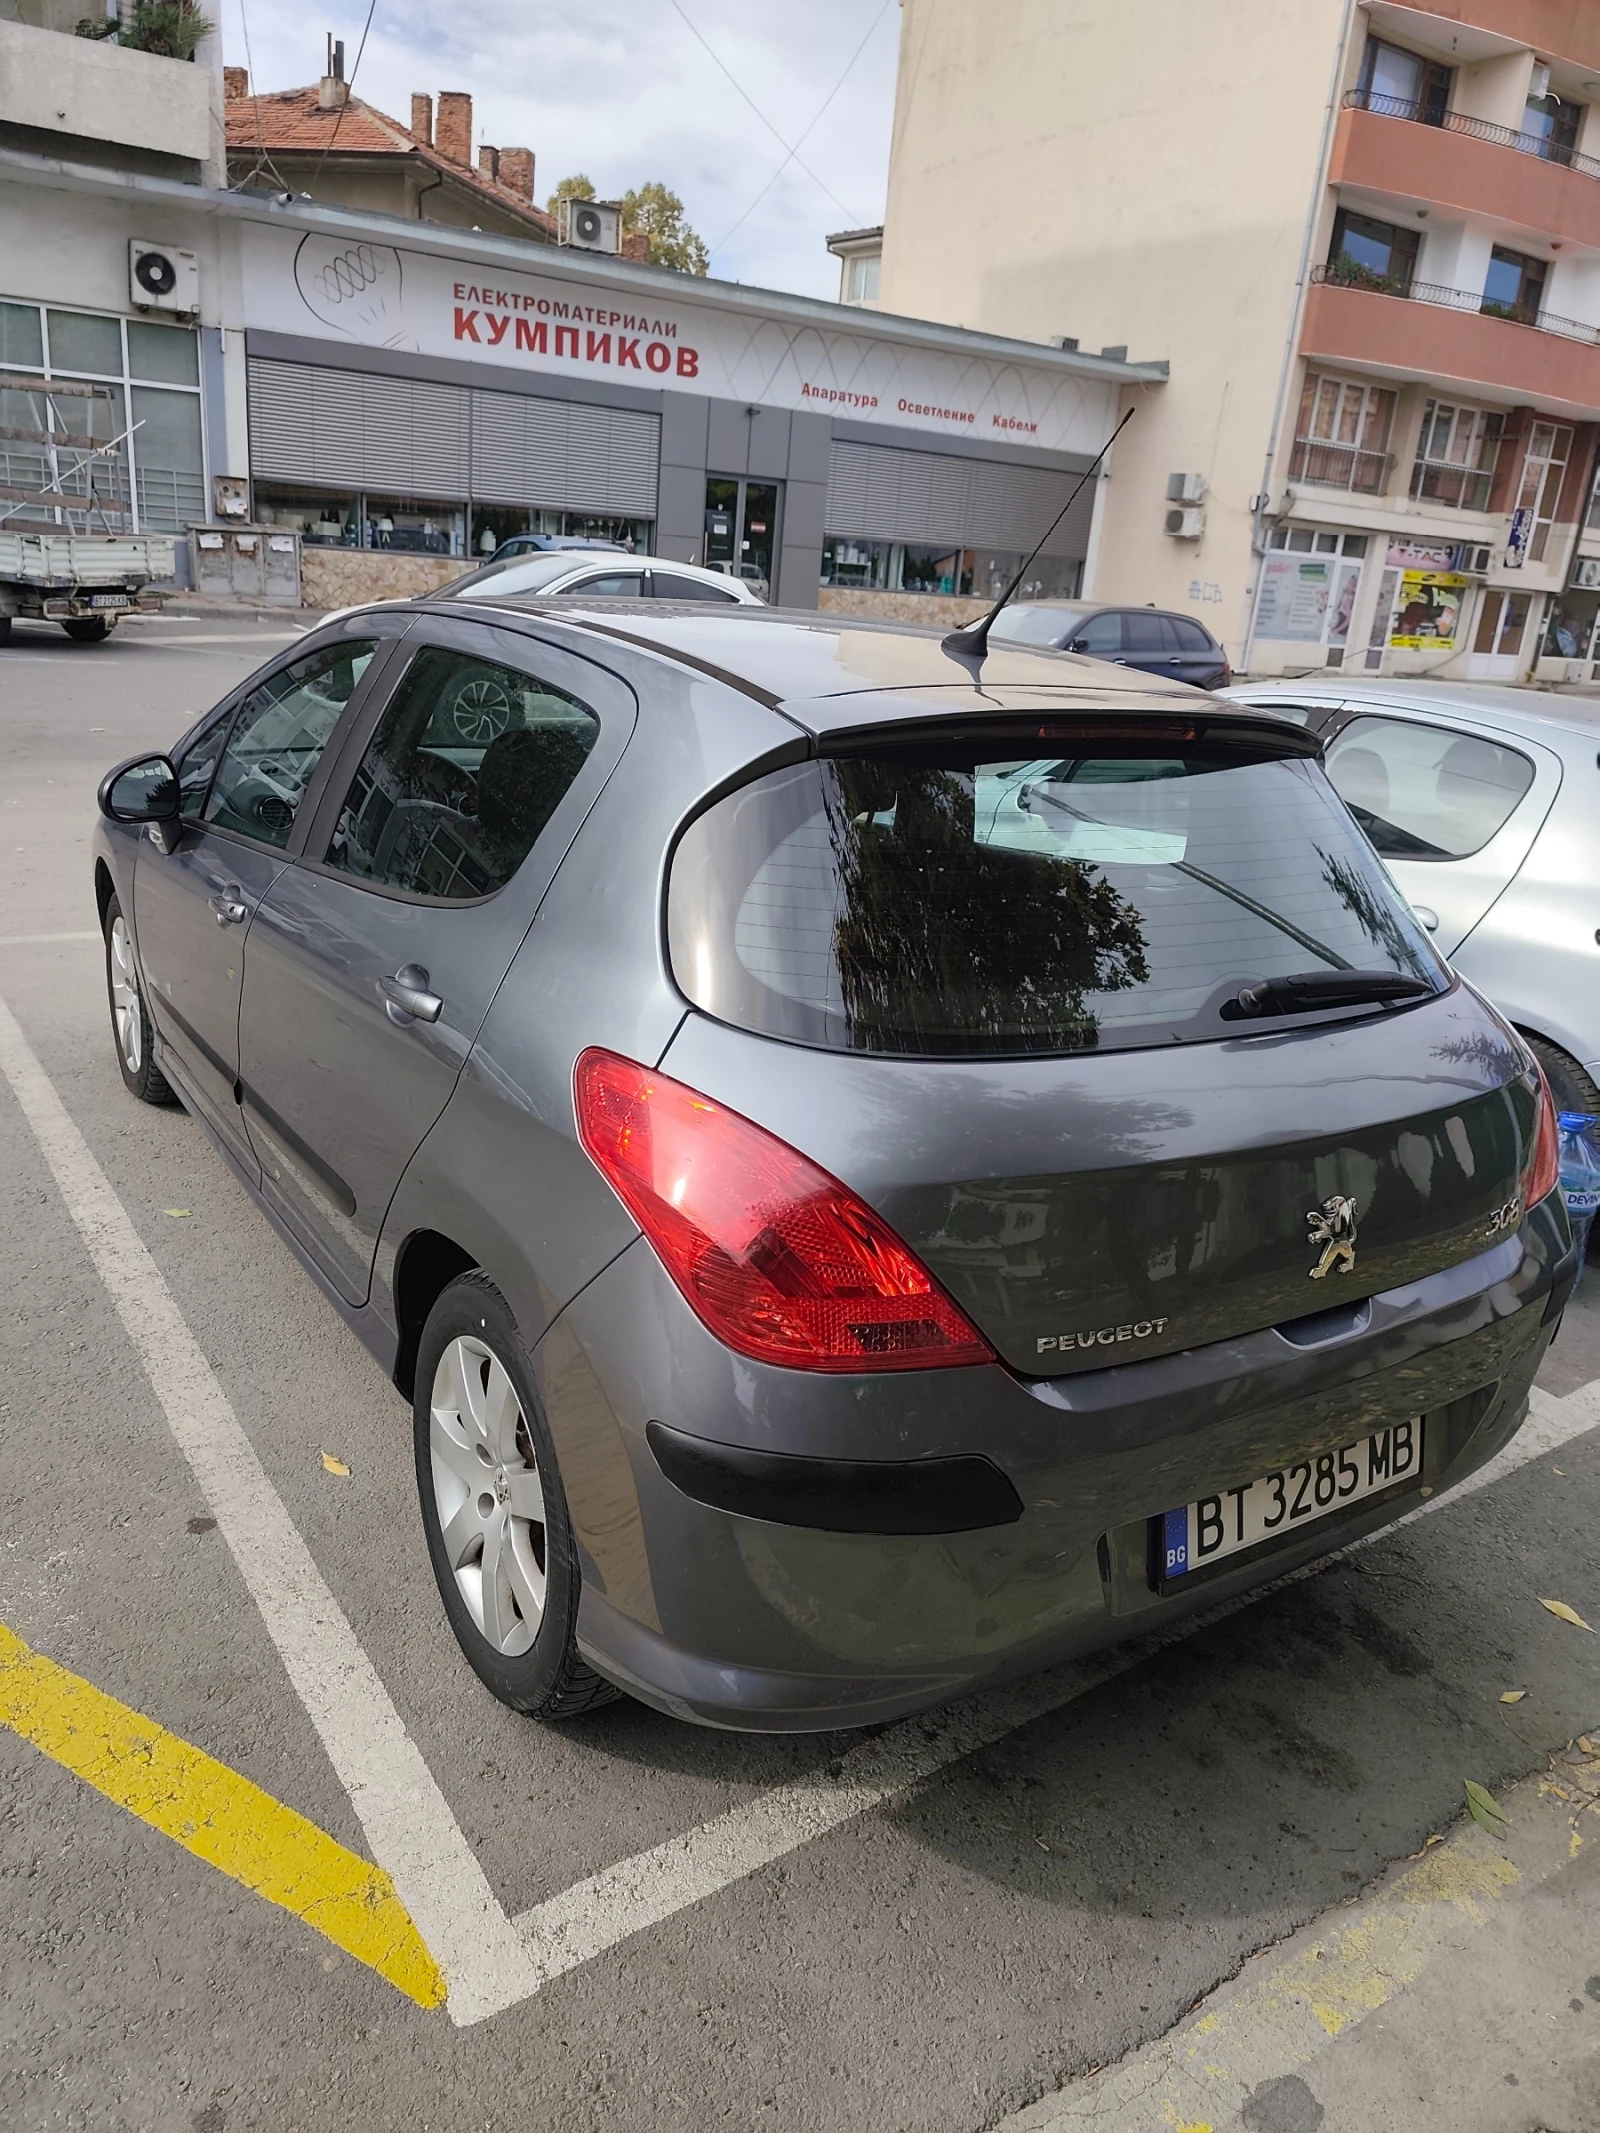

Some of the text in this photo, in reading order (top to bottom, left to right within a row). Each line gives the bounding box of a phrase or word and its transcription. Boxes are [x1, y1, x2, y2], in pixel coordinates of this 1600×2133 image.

[453, 283, 678, 338] ЕЛЕКТРОМАТЕРИАЛИ
[454, 307, 700, 378] КУМПИКОВ
[801, 382, 1038, 434] Апаратура Осветление Кабели
[1567, 1193, 1598, 1205] DEVIN
[1036, 1317, 1169, 1354] PEUGEOT
[1197, 1420, 1414, 1558] BT 3285 MB
[1166, 1545, 1186, 1568] BG
